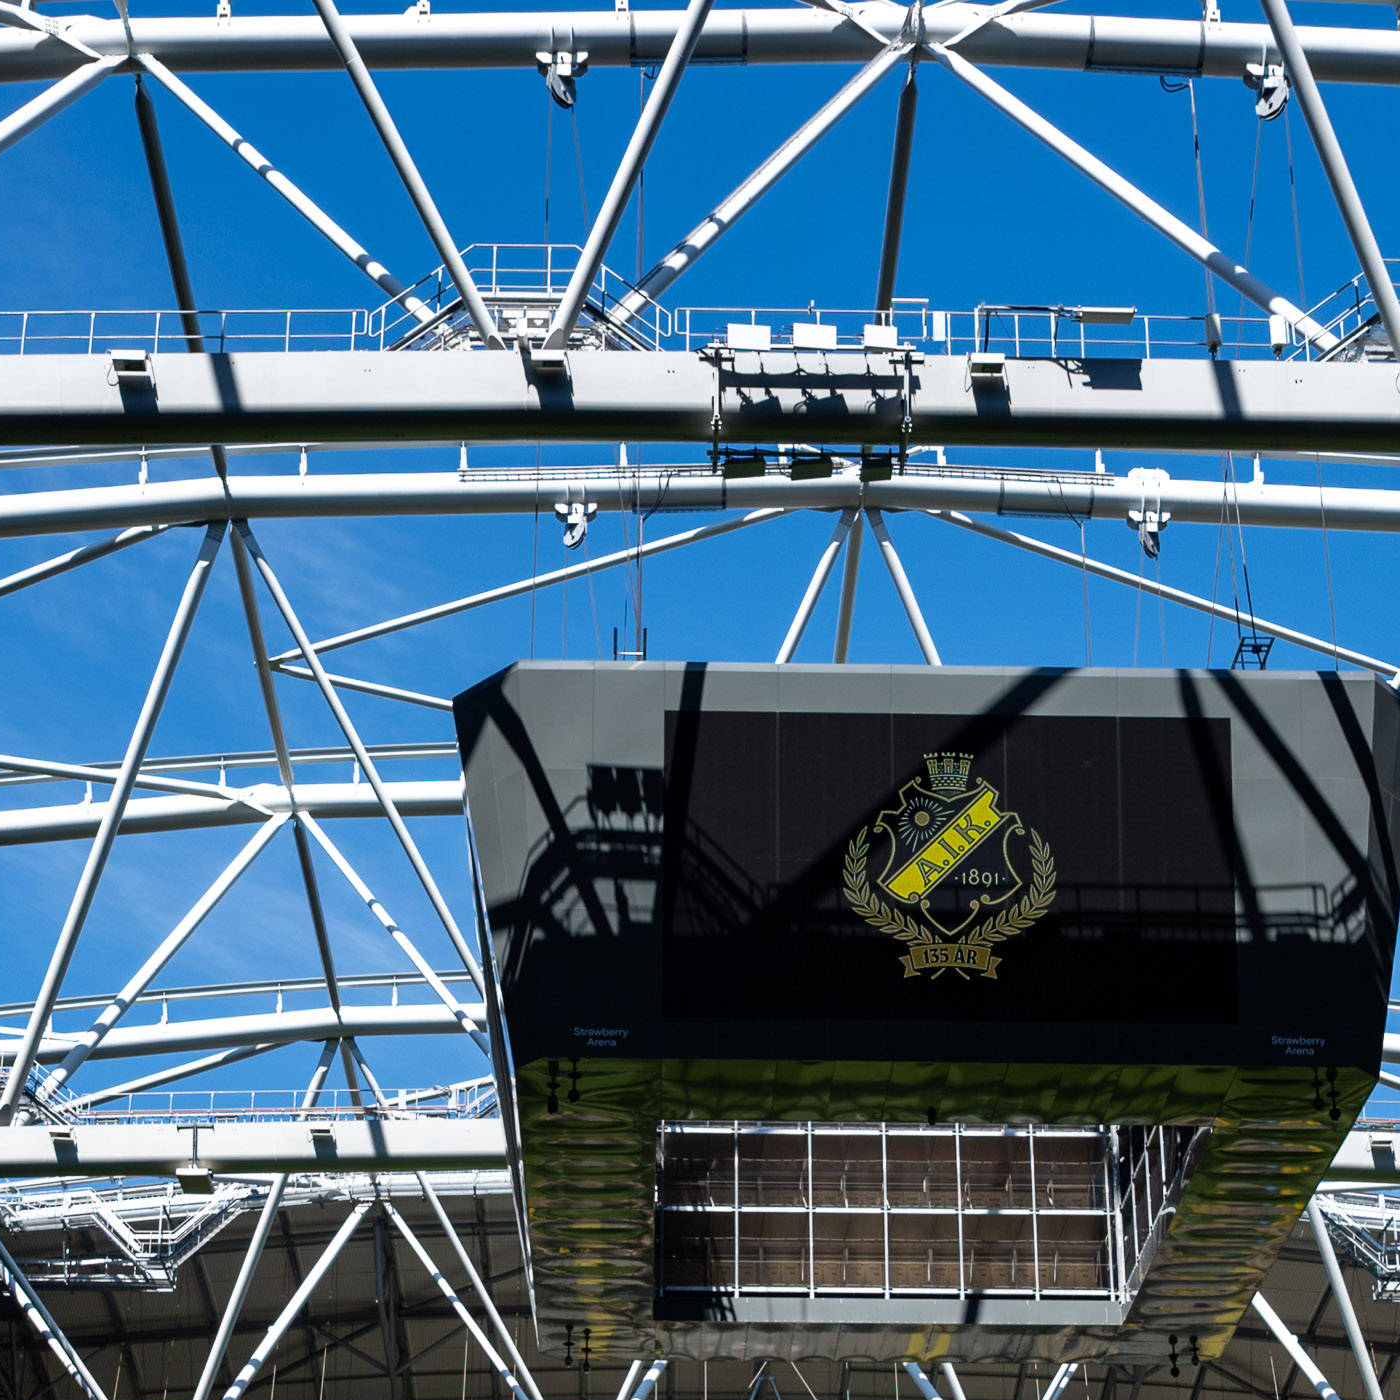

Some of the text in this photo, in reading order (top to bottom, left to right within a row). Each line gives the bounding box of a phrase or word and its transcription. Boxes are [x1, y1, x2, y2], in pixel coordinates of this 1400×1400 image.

[961, 869, 999, 887] 1891
[923, 949, 949, 965] 135
[573, 1026, 629, 1038] Strawberry
[586, 1038, 617, 1047] Arena
[1271, 1035, 1326, 1047] Strawberry
[1284, 1046, 1316, 1056] Arena
